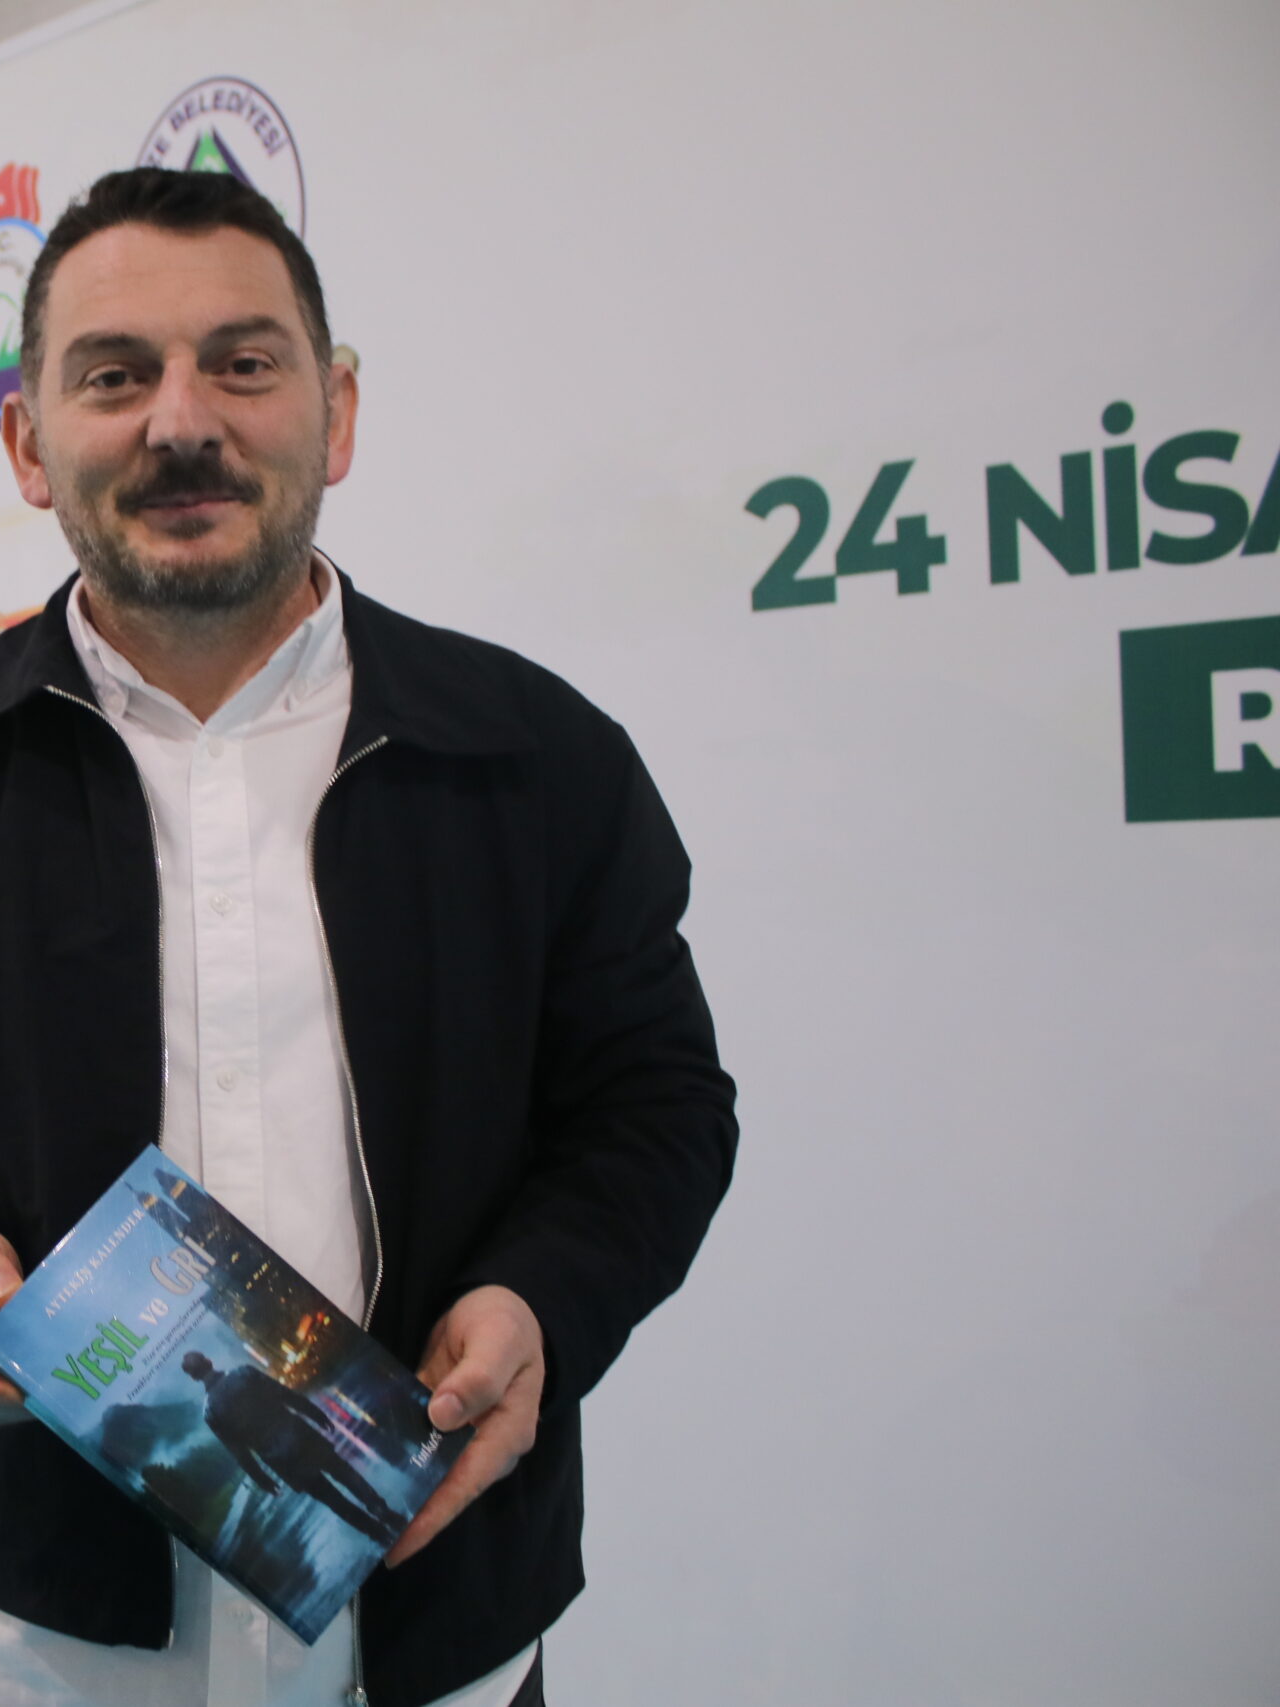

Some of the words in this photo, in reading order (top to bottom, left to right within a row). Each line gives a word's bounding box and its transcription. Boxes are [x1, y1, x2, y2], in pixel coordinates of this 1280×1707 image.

[743, 458, 948, 613] 24
[89, 1208, 146, 1270] KALENDER
[138, 1298, 169, 1326] ve
